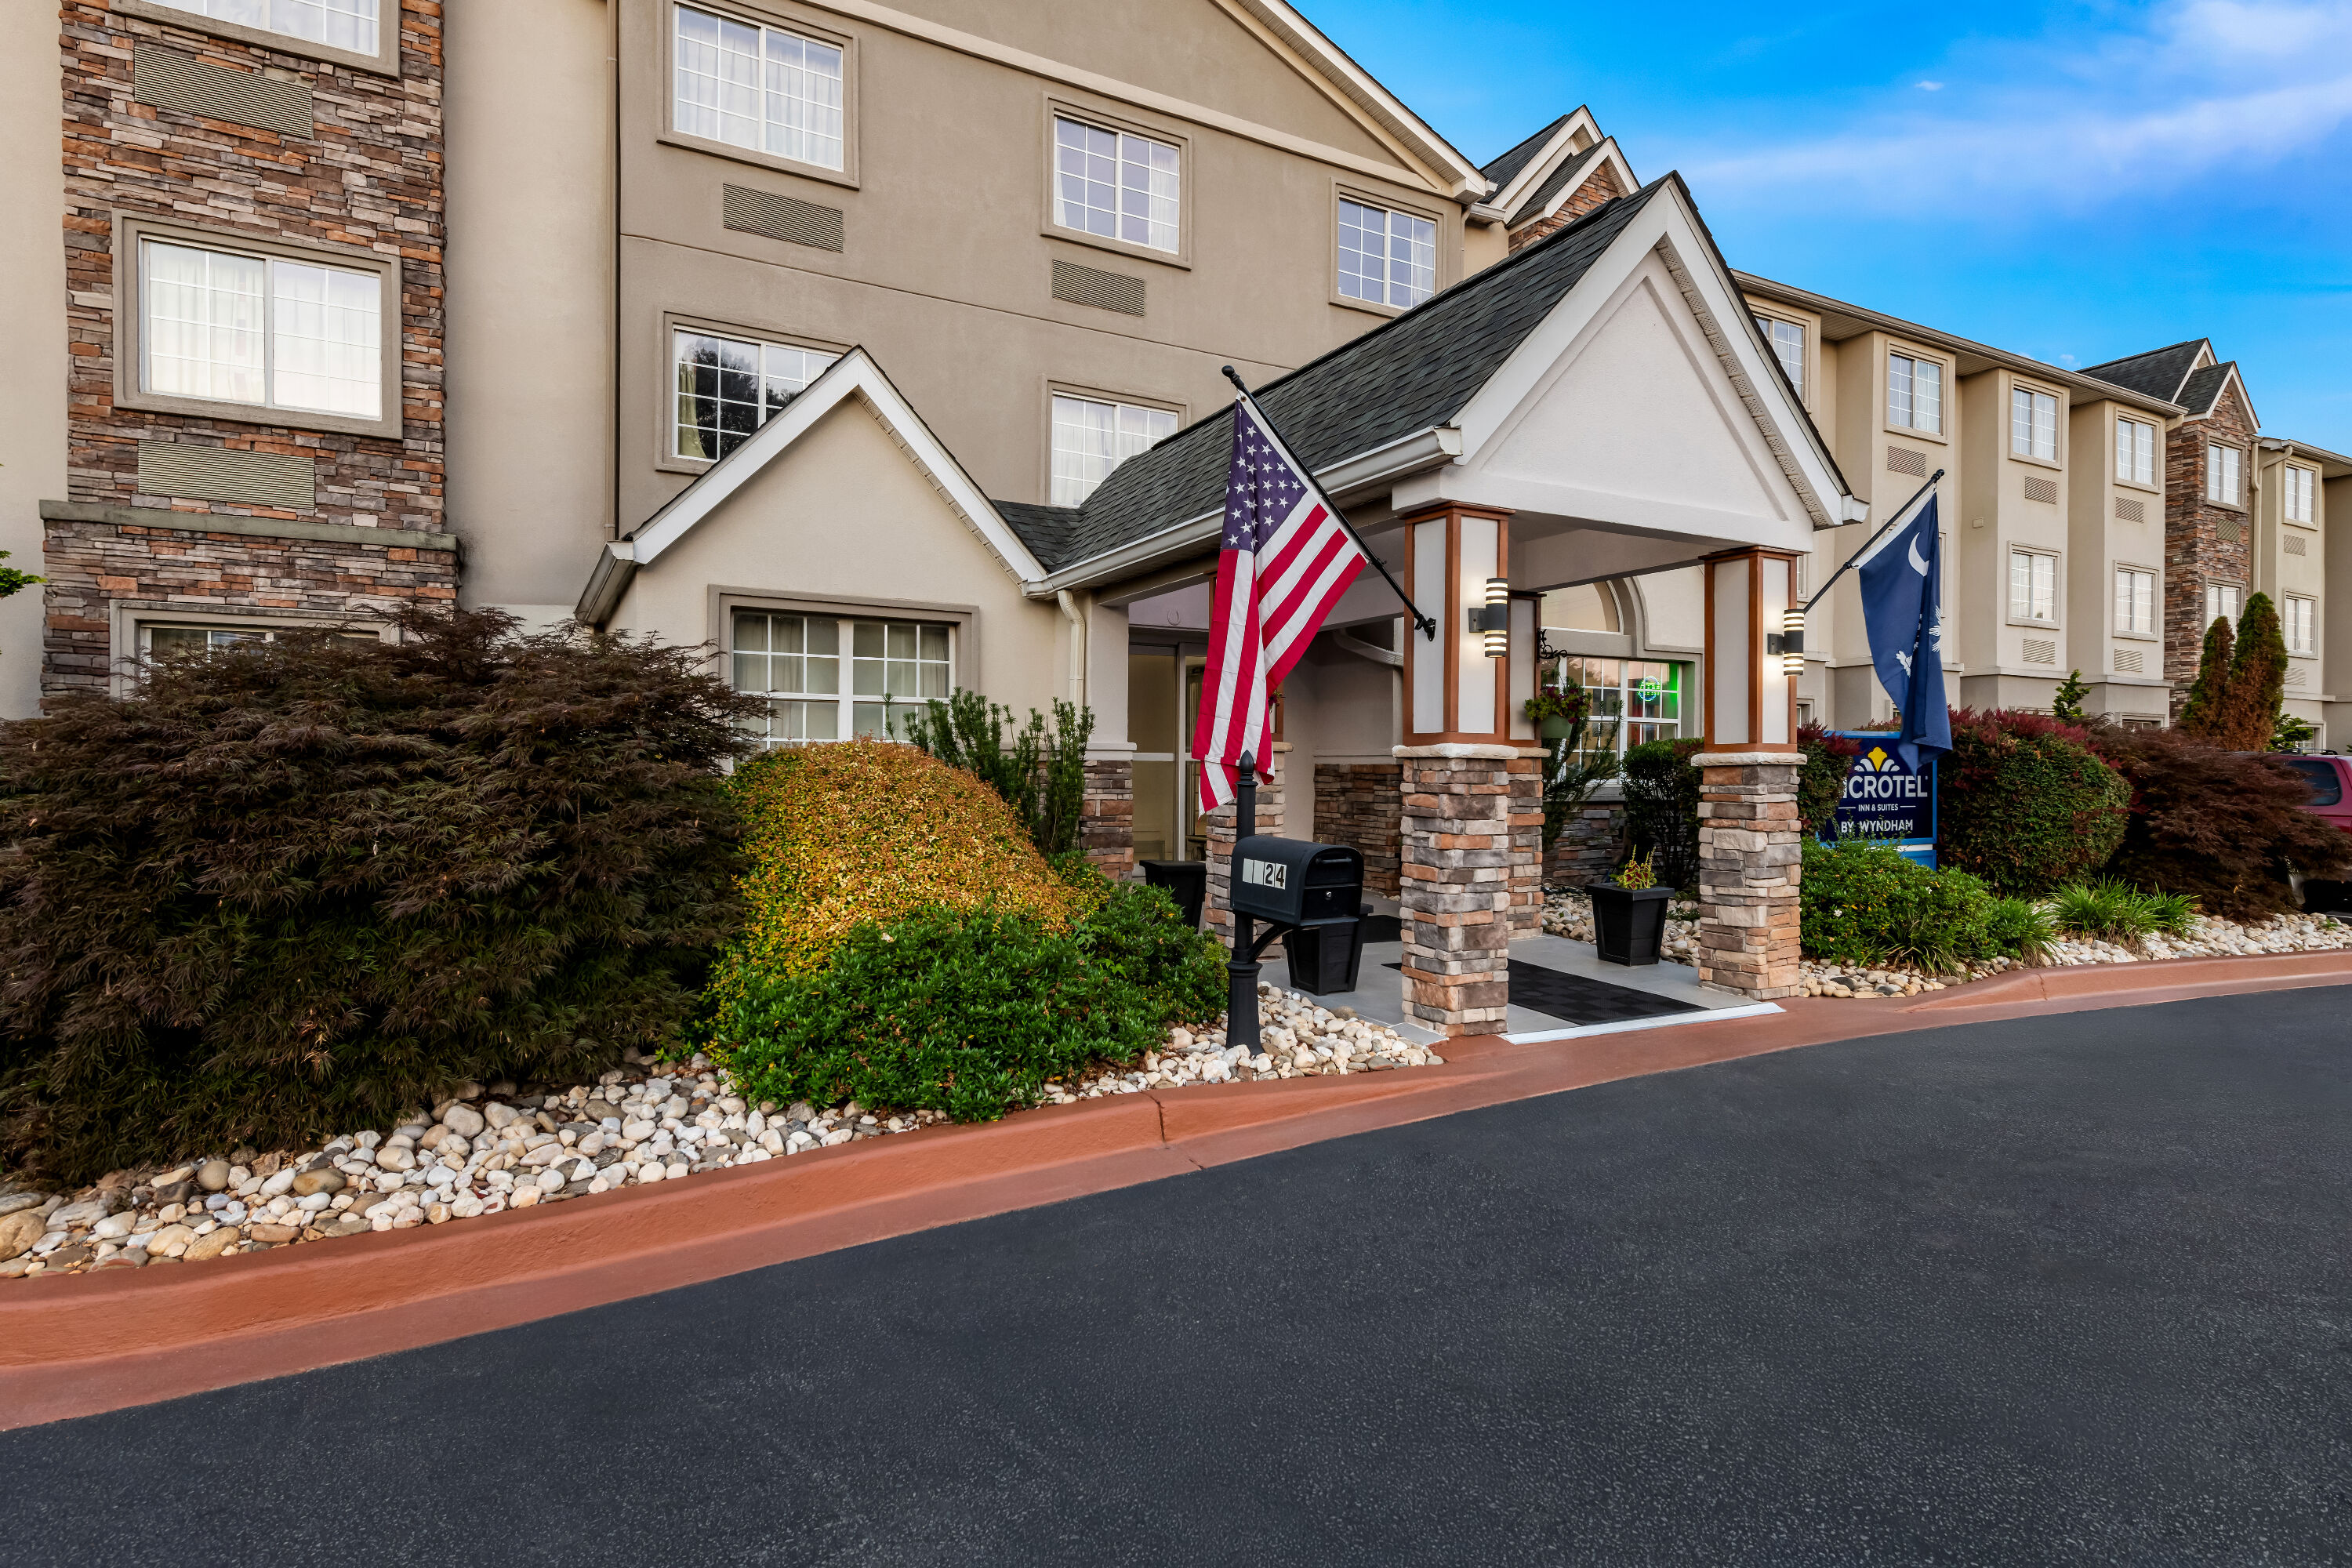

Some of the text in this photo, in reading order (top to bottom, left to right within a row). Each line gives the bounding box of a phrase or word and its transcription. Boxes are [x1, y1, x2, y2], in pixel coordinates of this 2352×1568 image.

[1842, 775, 1928, 799] ICROTEL
[1841, 819, 1913, 833] BY WYNDHAM
[1265, 863, 1285, 887] 24
